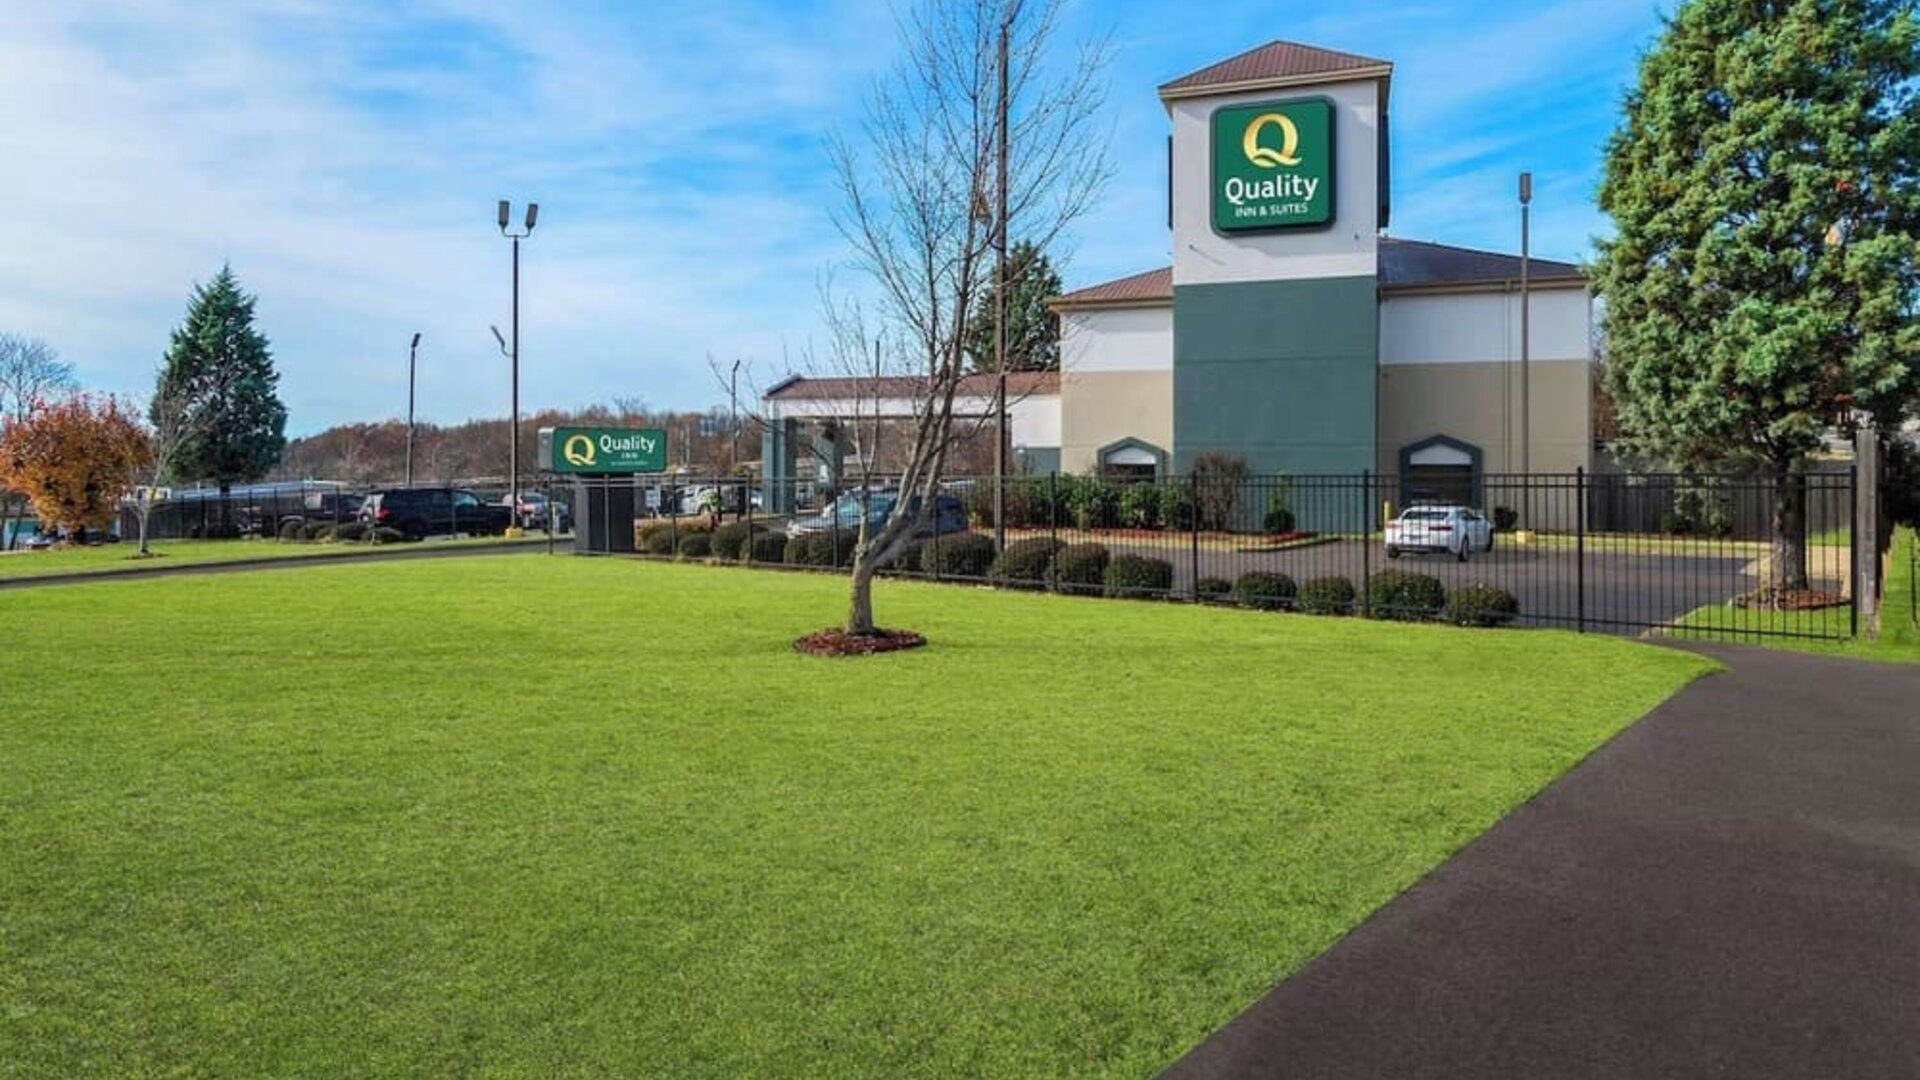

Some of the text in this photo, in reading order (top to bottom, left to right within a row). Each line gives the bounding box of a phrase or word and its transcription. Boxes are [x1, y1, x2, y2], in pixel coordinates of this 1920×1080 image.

[1243, 113, 1302, 168] Q
[1225, 174, 1319, 205] Quality
[1235, 202, 1309, 217] INN & SUITES
[564, 434, 597, 466] Q
[599, 434, 656, 454] Quality
